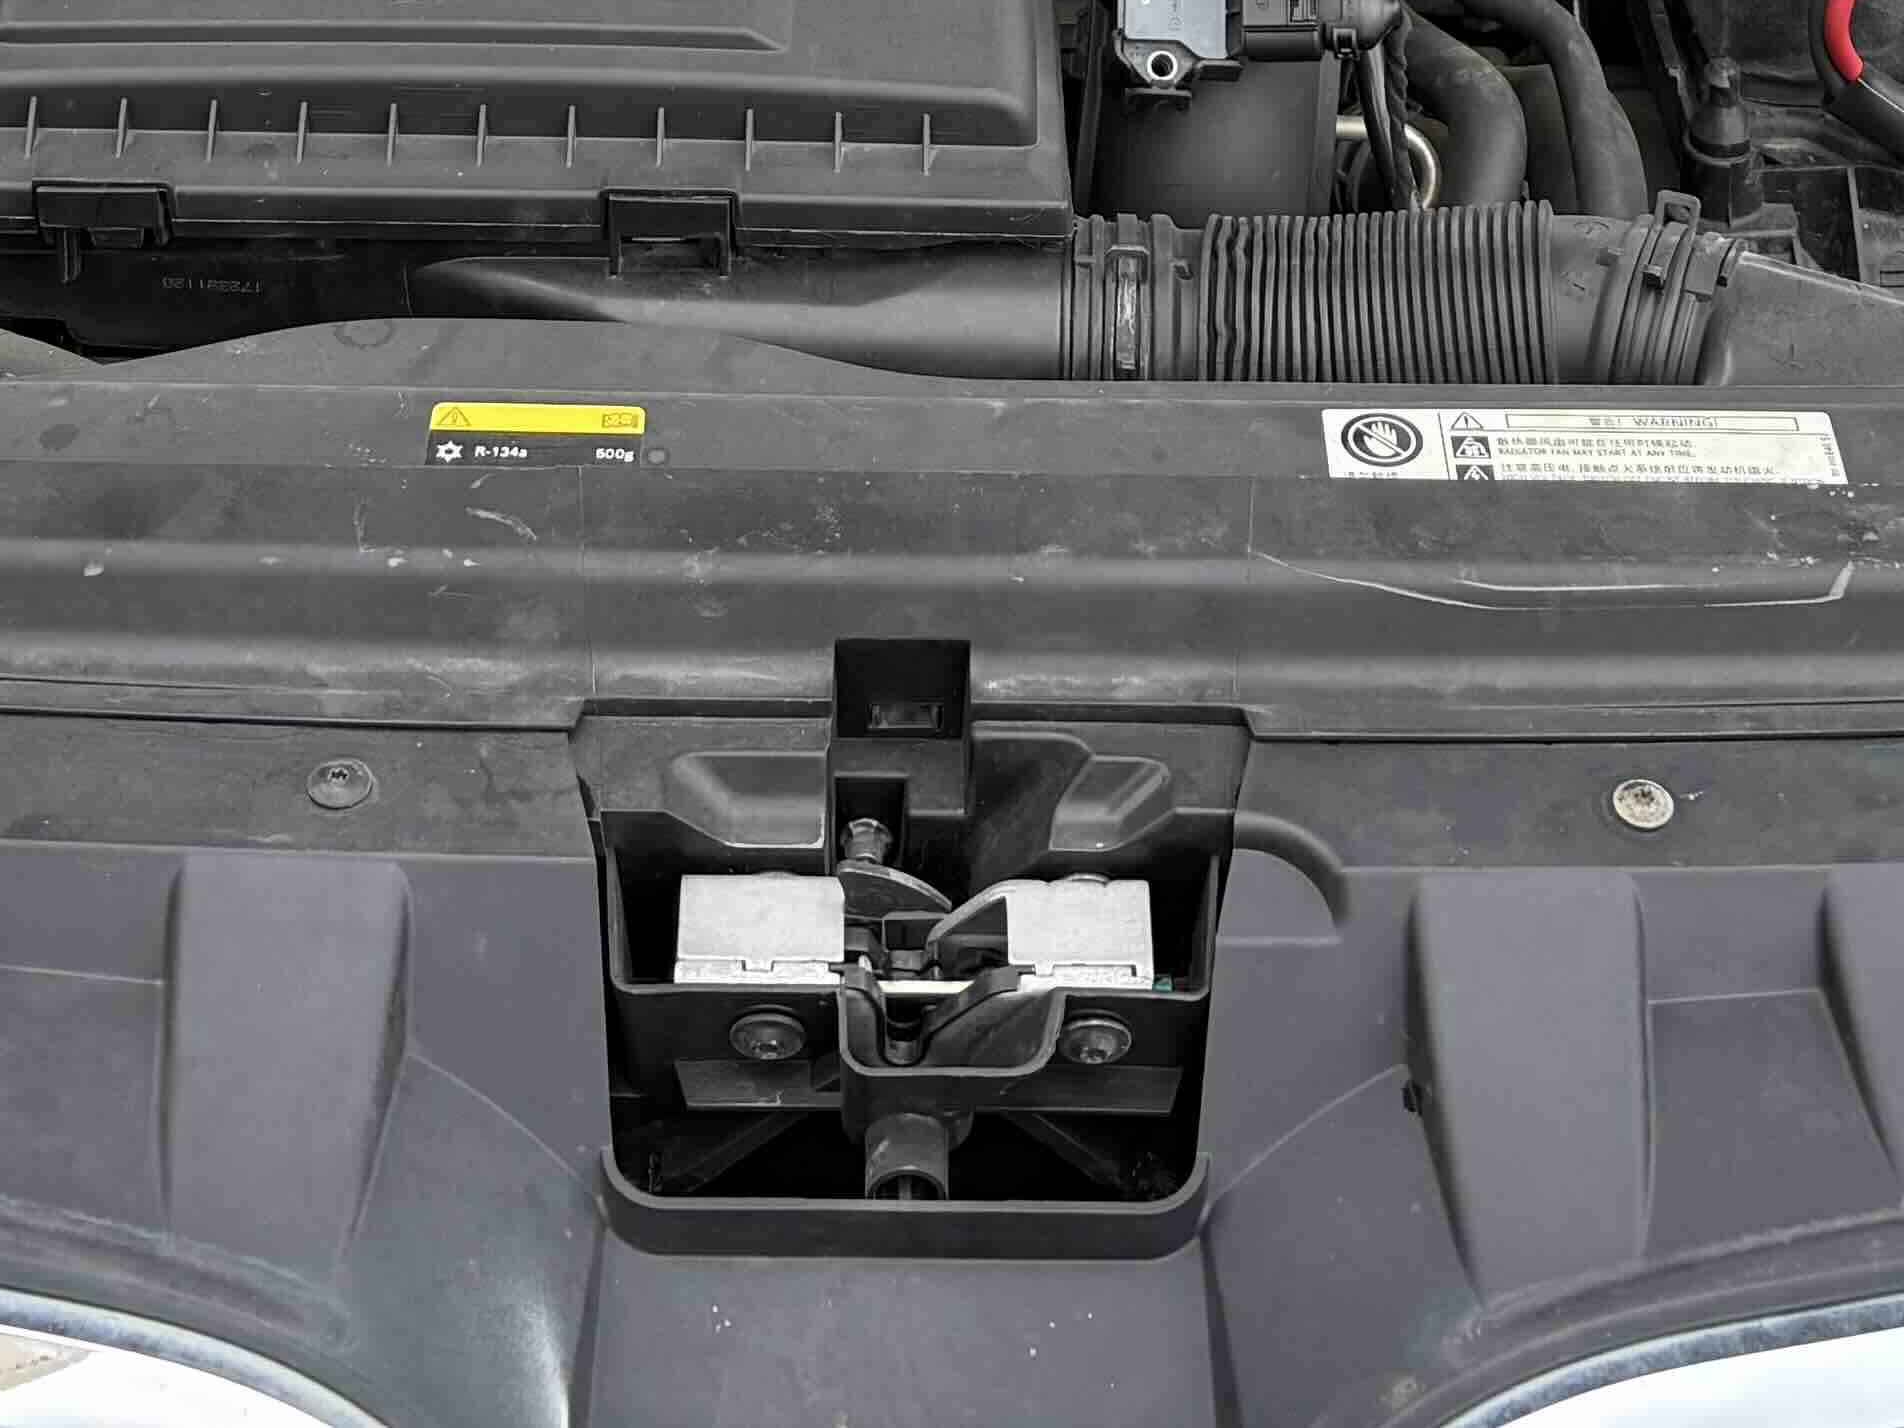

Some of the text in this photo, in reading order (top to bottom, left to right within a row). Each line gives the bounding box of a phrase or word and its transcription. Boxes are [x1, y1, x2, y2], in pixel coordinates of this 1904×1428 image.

[474, 446, 528, 459] R-134a
[1498, 448, 1547, 457] RADIATOR
[1550, 448, 1569, 457] FAN
[1572, 449, 1594, 457] MAY
[1598, 449, 1627, 457] START
[1631, 449, 1643, 457] AT
[1646, 450, 1666, 458] ANY
